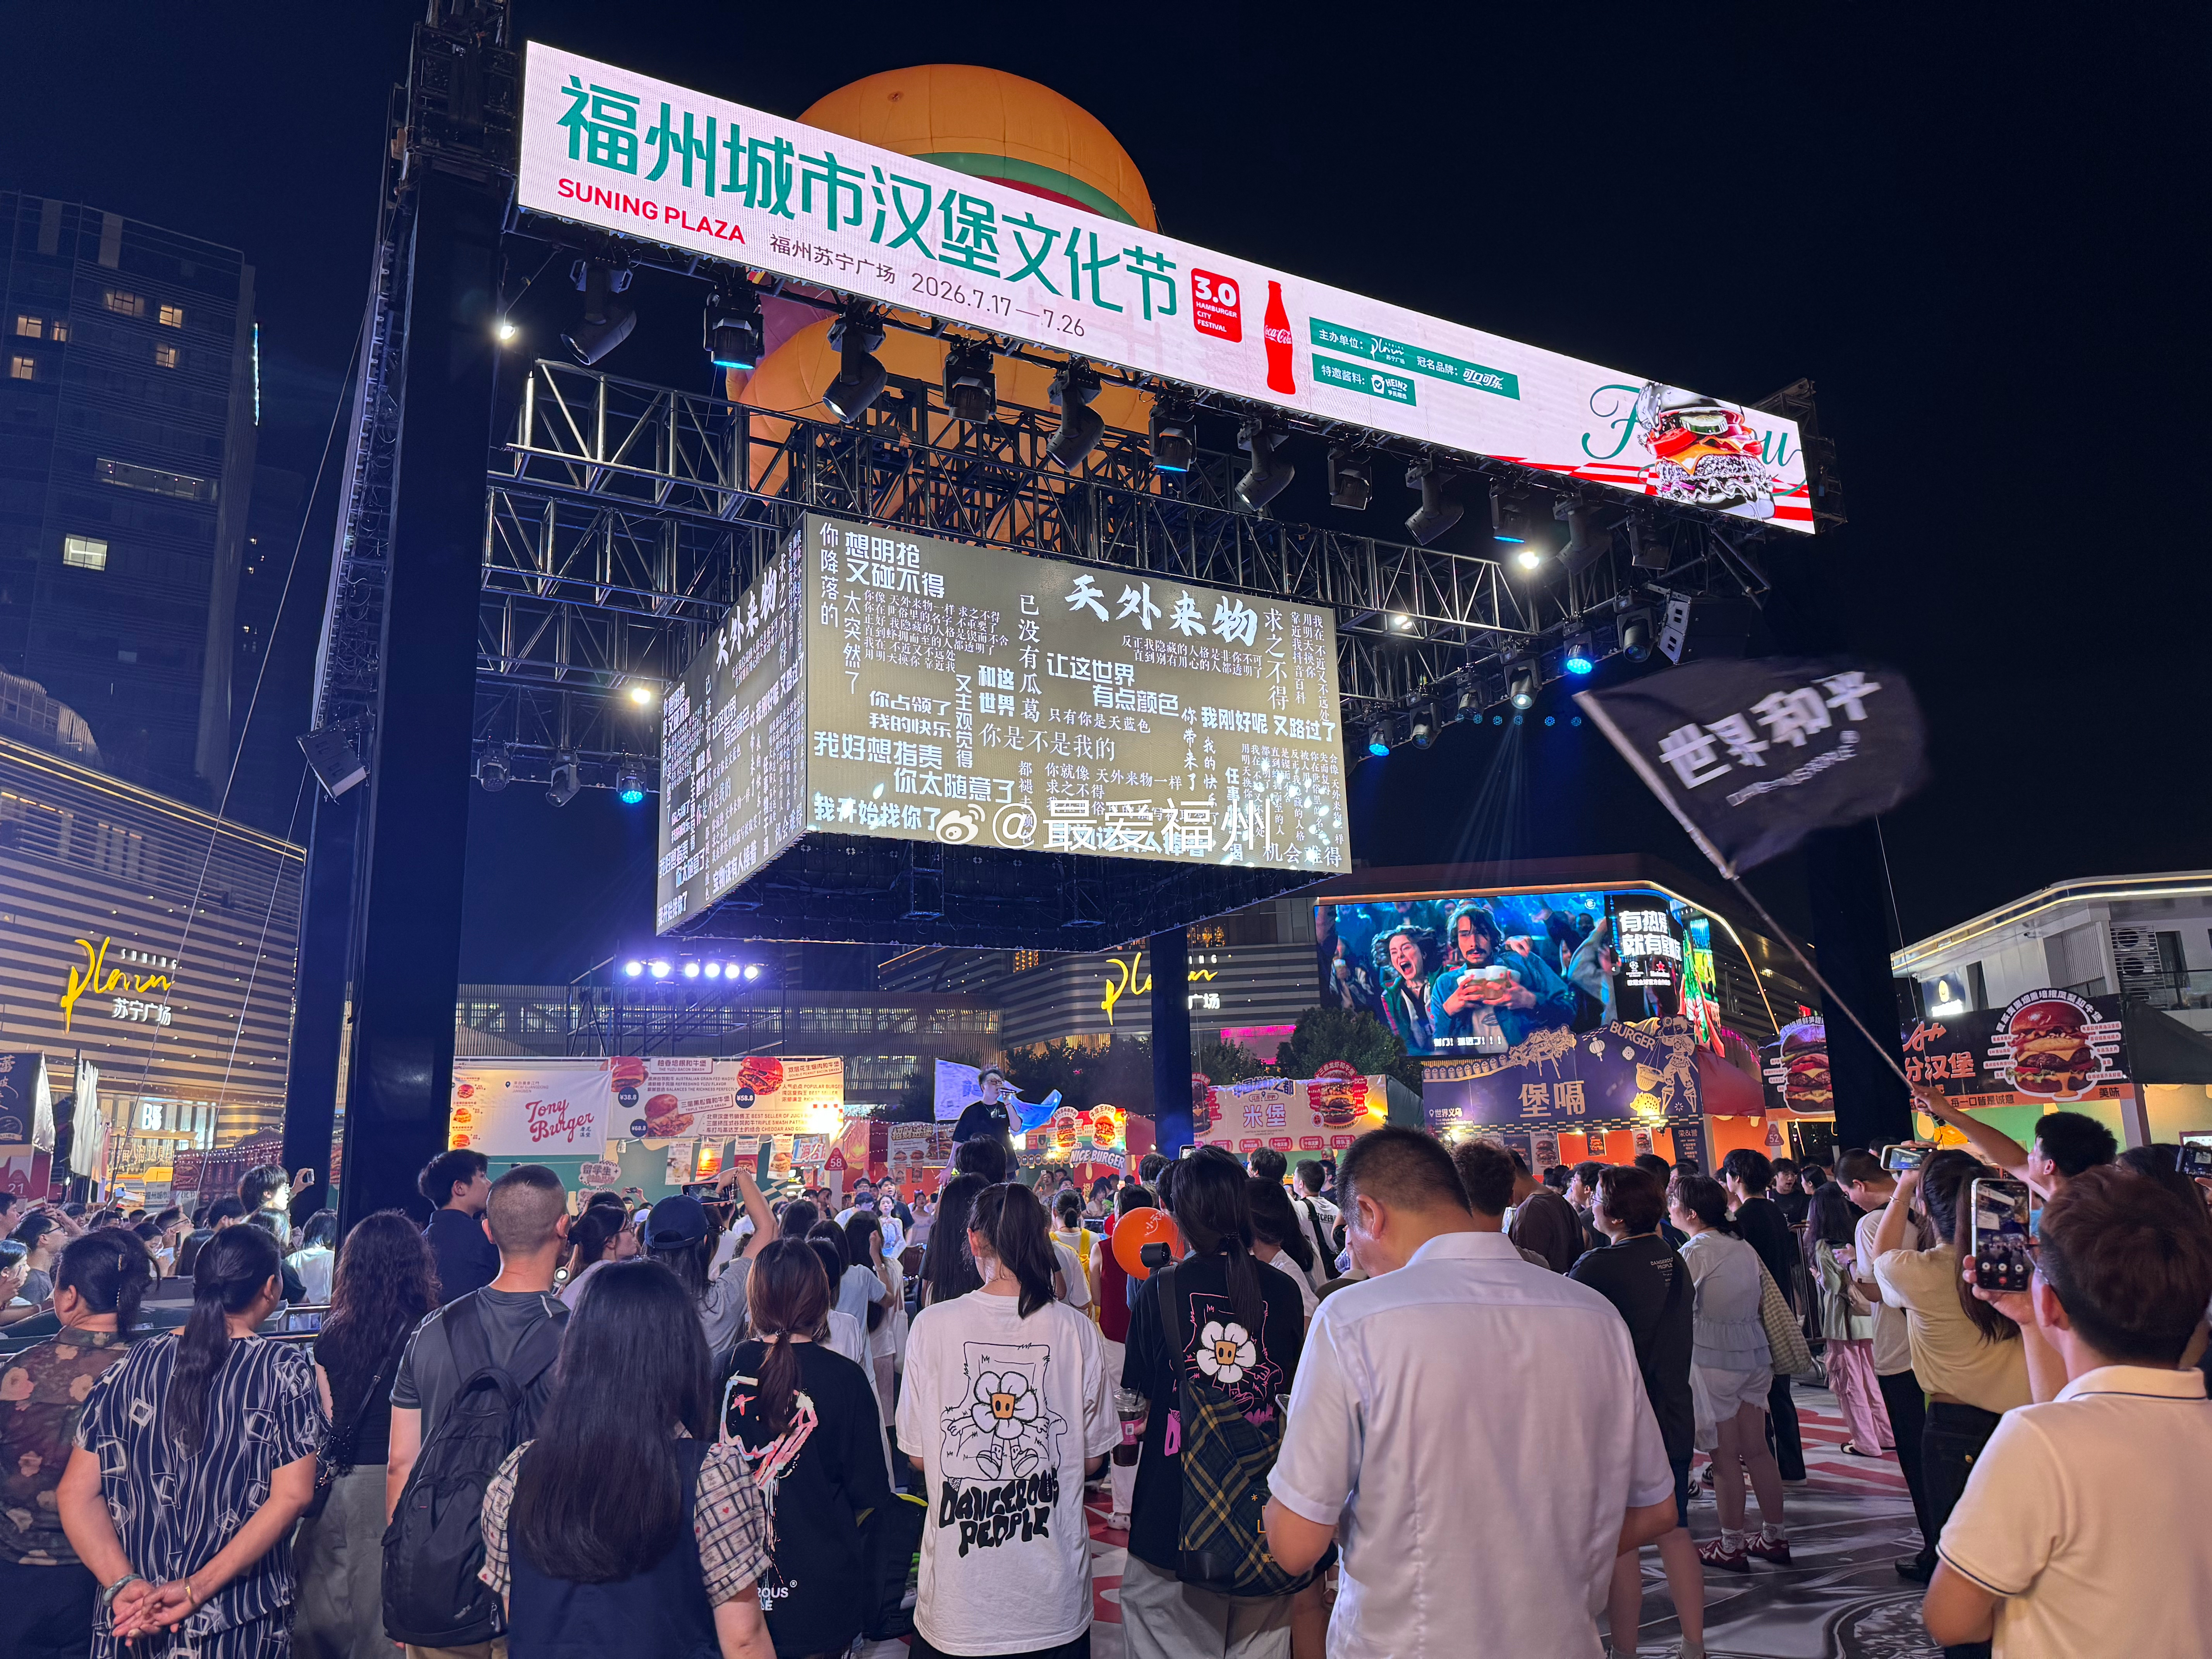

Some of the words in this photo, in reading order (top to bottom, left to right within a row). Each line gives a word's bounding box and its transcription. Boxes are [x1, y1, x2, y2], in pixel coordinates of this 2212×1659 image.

[557, 75, 1177, 322] 福州城市汉堡文化节
[558, 177, 659, 221] SUNING
[665, 205, 746, 246] PLAZA
[769, 233, 896, 286] 福州苏宁广场
[1194, 275, 1237, 307] 3.0
[1196, 301, 1237, 318] HAMBURGER
[1197, 311, 1211, 319] CITY
[1197, 319, 1227, 332] FESTIVAL
[1384, 378, 1408, 392] HEINZ
[845, 532, 920, 568] 想明抢
[820, 522, 839, 627] 你降落的
[846, 558, 945, 598] 又碰不得
[716, 567, 777, 670] 天外来物
[778, 553, 787, 671] 求之不得
[1066, 575, 1257, 646] 天外来物
[843, 591, 861, 694] 太突然了
[1018, 595, 1042, 723] 已没有瓜葛
[1047, 653, 1135, 687] 让这世界
[1264, 608, 1289, 710] 求之不得
[978, 665, 1014, 690] 和这
[869, 690, 951, 716] 你占领了
[979, 692, 1015, 717] 世界
[1093, 684, 1179, 716] 有点颜色
[869, 713, 951, 738] 我的快乐
[955, 674, 973, 768] 又主观觉得
[1049, 708, 1151, 733] 只有你是天蓝色
[1201, 706, 1267, 734] 我刚好呢
[1273, 715, 1336, 742] 又路过了
[1658, 671, 1882, 789] 世界和平
[814, 731, 942, 769] 我好想指责
[979, 723, 1115, 761] 你是不是我的
[1181, 707, 1199, 791] 你带来了
[894, 767, 1015, 804] 你太随意了
[1045, 762, 1090, 781] 你就像
[1096, 768, 1182, 790] 天外来物一样
[1203, 736, 1218, 808] 我的快乐
[1046, 779, 1105, 799] 求之不得
[120, 948, 179, 970] SUNING
[112, 997, 172, 1027] 苏宁广场
[1188, 993, 1220, 1009] 广场
[1610, 1020, 1656, 1051] BURGER
[1905, 1051, 1976, 1082] 分汉堡
[1518, 1080, 1586, 1118] 堡嗝
[2099, 1087, 2120, 1097] 美味
[525, 1099, 569, 1123] Tony
[1243, 1104, 1286, 1128] 米堡
[529, 1112, 594, 1143] Burger
[1769, 1134, 1779, 1142] 52
[830, 1158, 842, 1167] 58
[1070, 1150, 1091, 1163] NICE
[1091, 1150, 1125, 1168] BURGER
[8, 1183, 24, 1194] 21
[939, 1469, 1060, 1528] DANGEROUS
[960, 1506, 1049, 1558] PEOPLE
